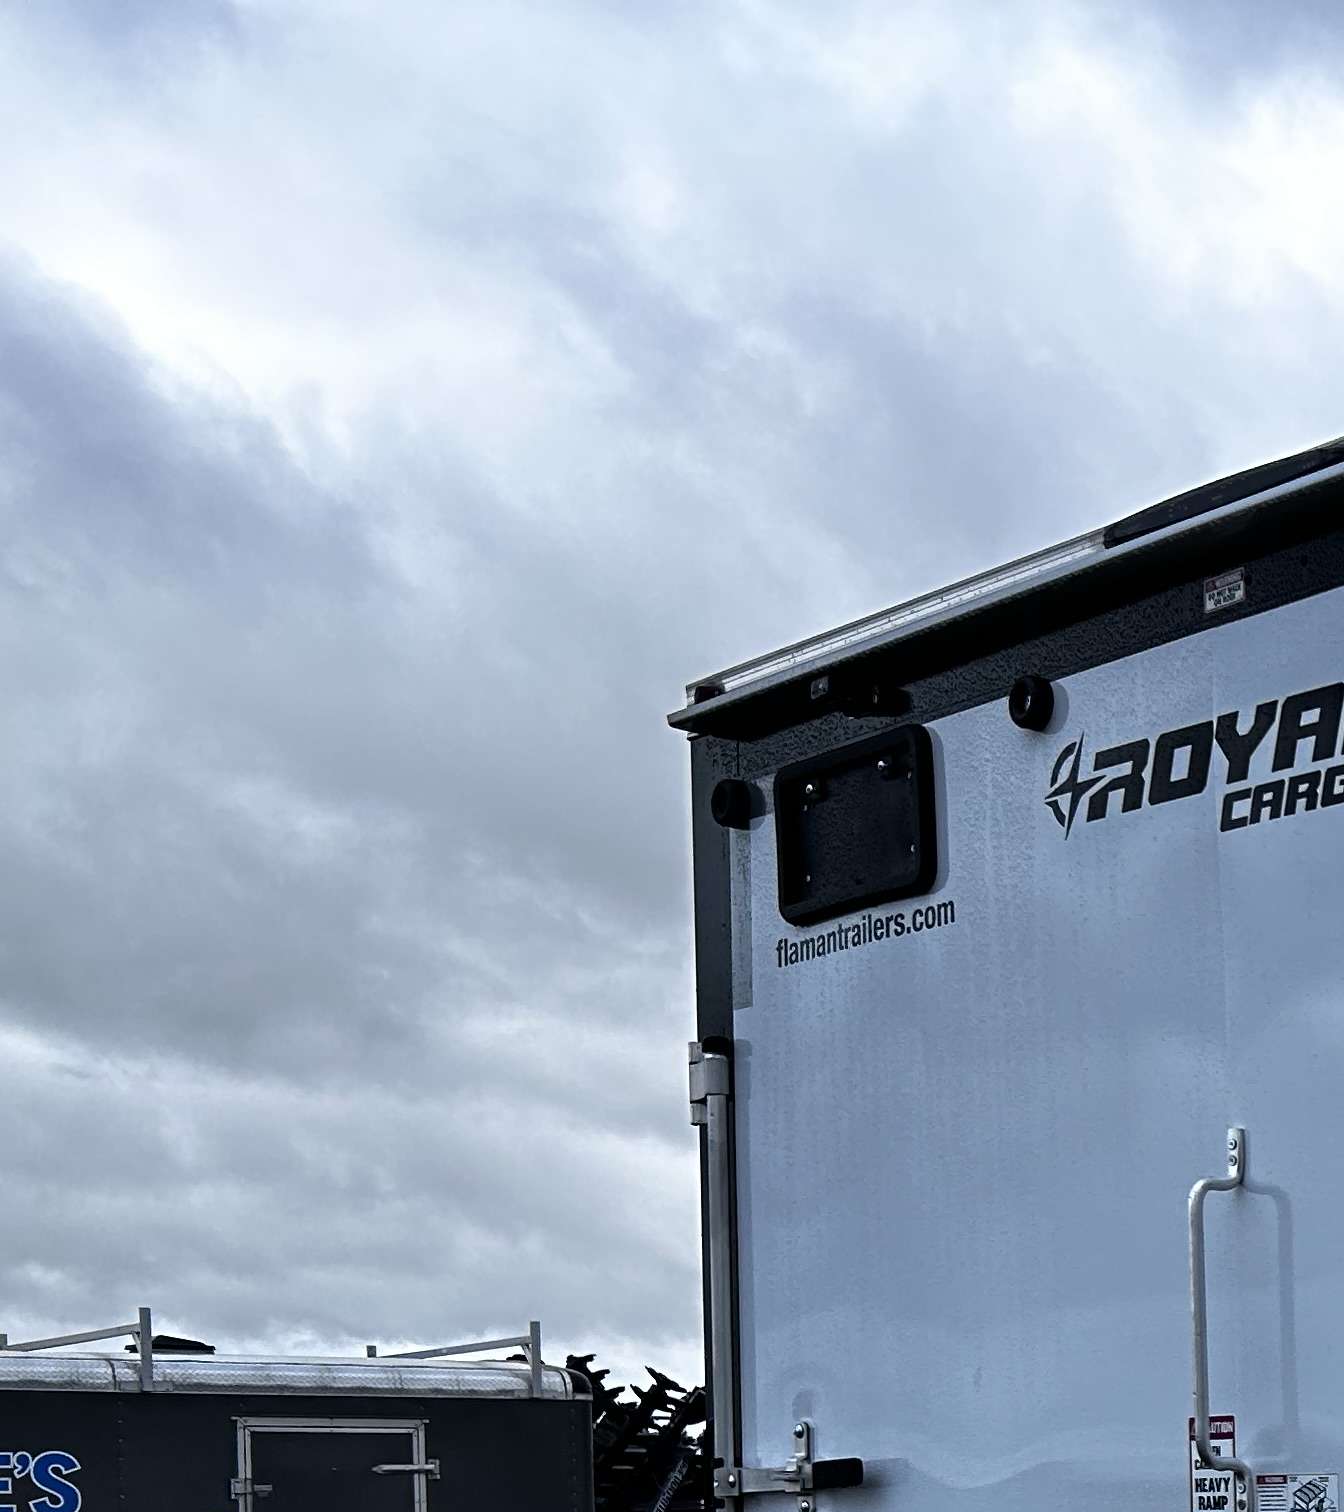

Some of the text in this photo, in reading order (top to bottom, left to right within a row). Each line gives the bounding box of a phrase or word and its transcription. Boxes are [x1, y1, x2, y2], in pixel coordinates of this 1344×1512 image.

[776, 900, 956, 968] flamantrailers.com
[1194, 1476, 1231, 1493] HEAVY
[1198, 1495, 1229, 1511] RAMP
